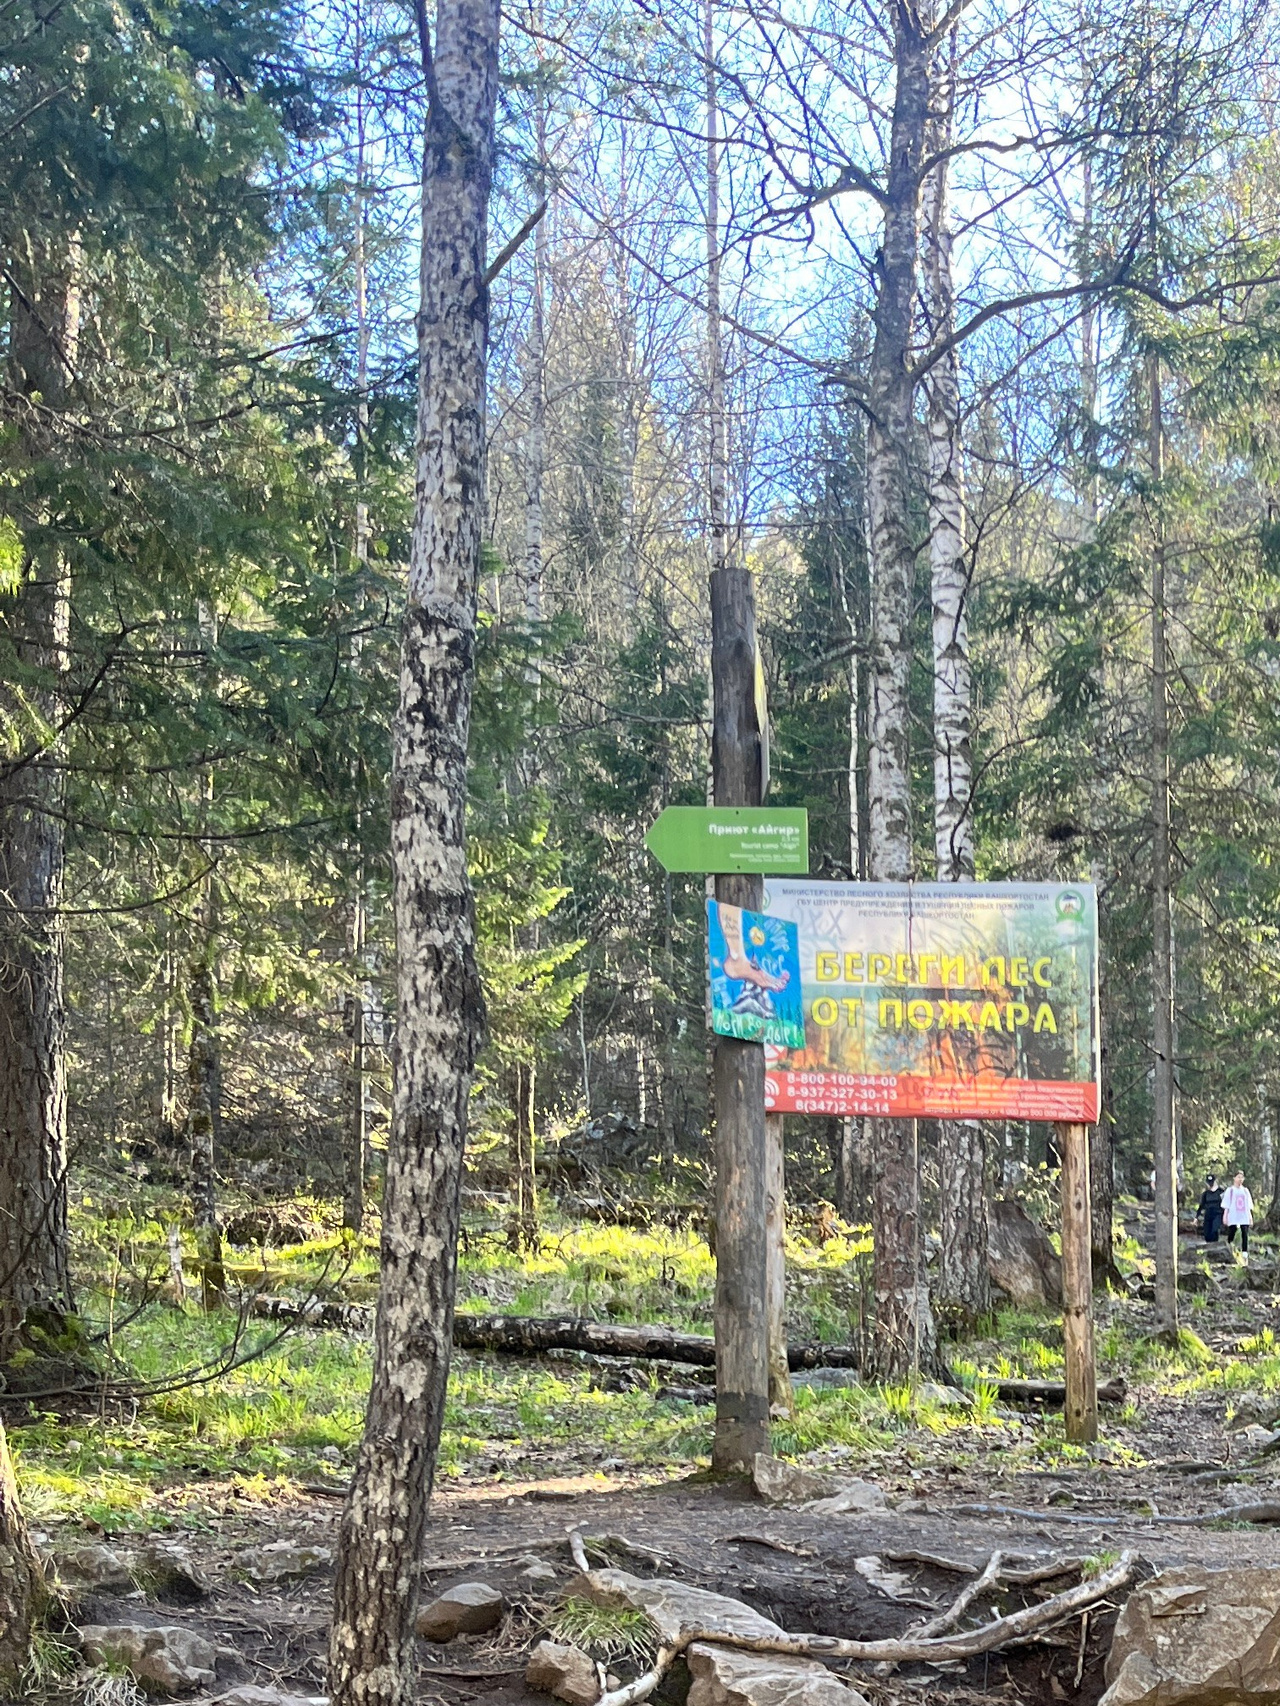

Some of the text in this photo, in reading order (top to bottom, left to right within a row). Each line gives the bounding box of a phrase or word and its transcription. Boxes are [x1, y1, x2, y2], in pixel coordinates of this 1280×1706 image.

[708, 823, 800, 838] Приют «Айгир»
[815, 950, 1053, 989] БЕРЕГИ ЛЕС
[810, 996, 1059, 1035] ОТ ПОЖАРА
[786, 1071, 898, 1087] 8-800-100-94-00
[786, 1085, 898, 1100] 8-937-327-30-13
